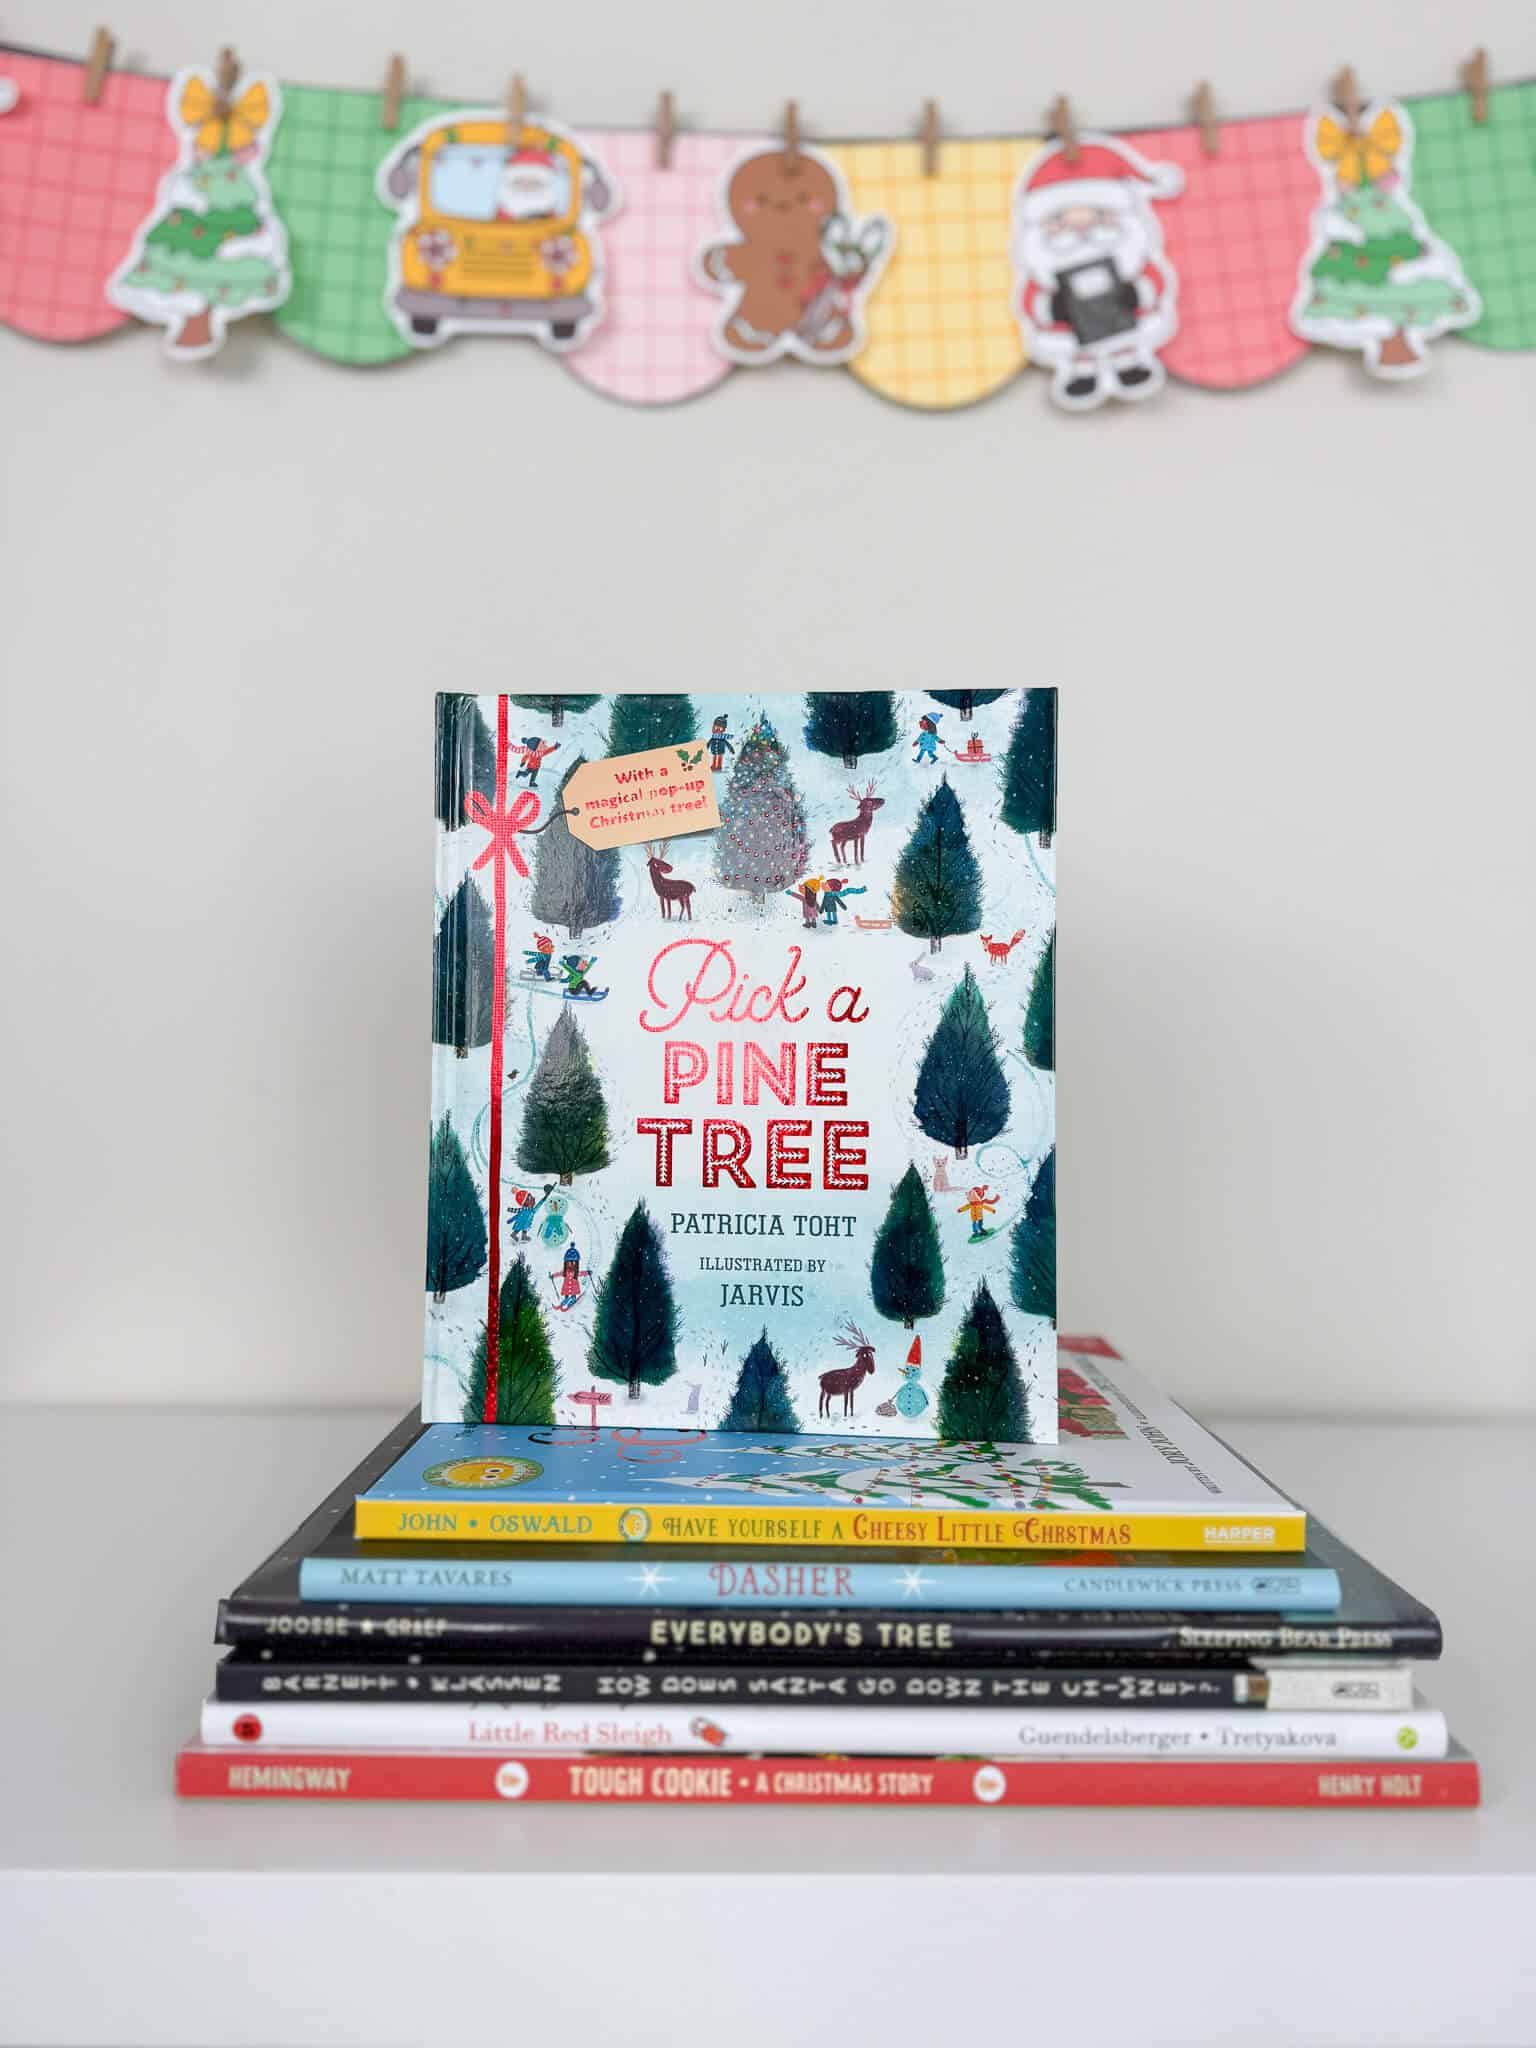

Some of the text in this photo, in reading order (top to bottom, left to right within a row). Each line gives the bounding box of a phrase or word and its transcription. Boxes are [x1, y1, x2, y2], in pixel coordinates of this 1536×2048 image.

[614, 766, 669, 785] With a
[585, 779, 705, 810] magical pop-up
[669, 795, 708, 814] tree!
[639, 938, 870, 1032] Pick a
[664, 1040, 849, 1106] PINE
[637, 1118, 870, 1191] TREE
[670, 1212, 857, 1237] PATRICIA TOHT
[699, 1257, 826, 1273] ILLUSTRATED BY
[719, 1283, 804, 1308] JARVIS
[397, 1513, 593, 1534] JOHN OSWALD
[662, 1517, 719, 1537] HAVE
[728, 1518, 823, 1538] YOURSELF
[832, 1522, 845, 1539] A
[1203, 1526, 1276, 1541] HARPER
[341, 1567, 513, 1587] MATT TAVARES
[709, 1562, 854, 1598] DASHER
[1063, 1577, 1186, 1593] CANDLEWICK
[1191, 1578, 1242, 1593] PRESS
[265, 1616, 349, 1635] JOOSSE
[650, 1619, 953, 1648] EVERYBODY'S TREE
[261, 1673, 561, 1693] BARNETT KLASSEN
[597, 1674, 651, 1697] HOW
[661, 1675, 738, 1694] DOES
[749, 1676, 847, 1695] SANTA
[857, 1677, 896, 1695] GO
[906, 1676, 982, 1699] DOWN
[992, 1678, 1050, 1697] THE
[468, 1721, 673, 1748] Little Red Sleigh
[1018, 1726, 1338, 1751] Guendelsberger Tretyakova
[228, 1764, 352, 1792] HEMINGWAY
[568, 1765, 934, 1797] TOUGH COOKIE A CHRISTMAS STORY
[1317, 1775, 1422, 1797] HENRY HOLT
